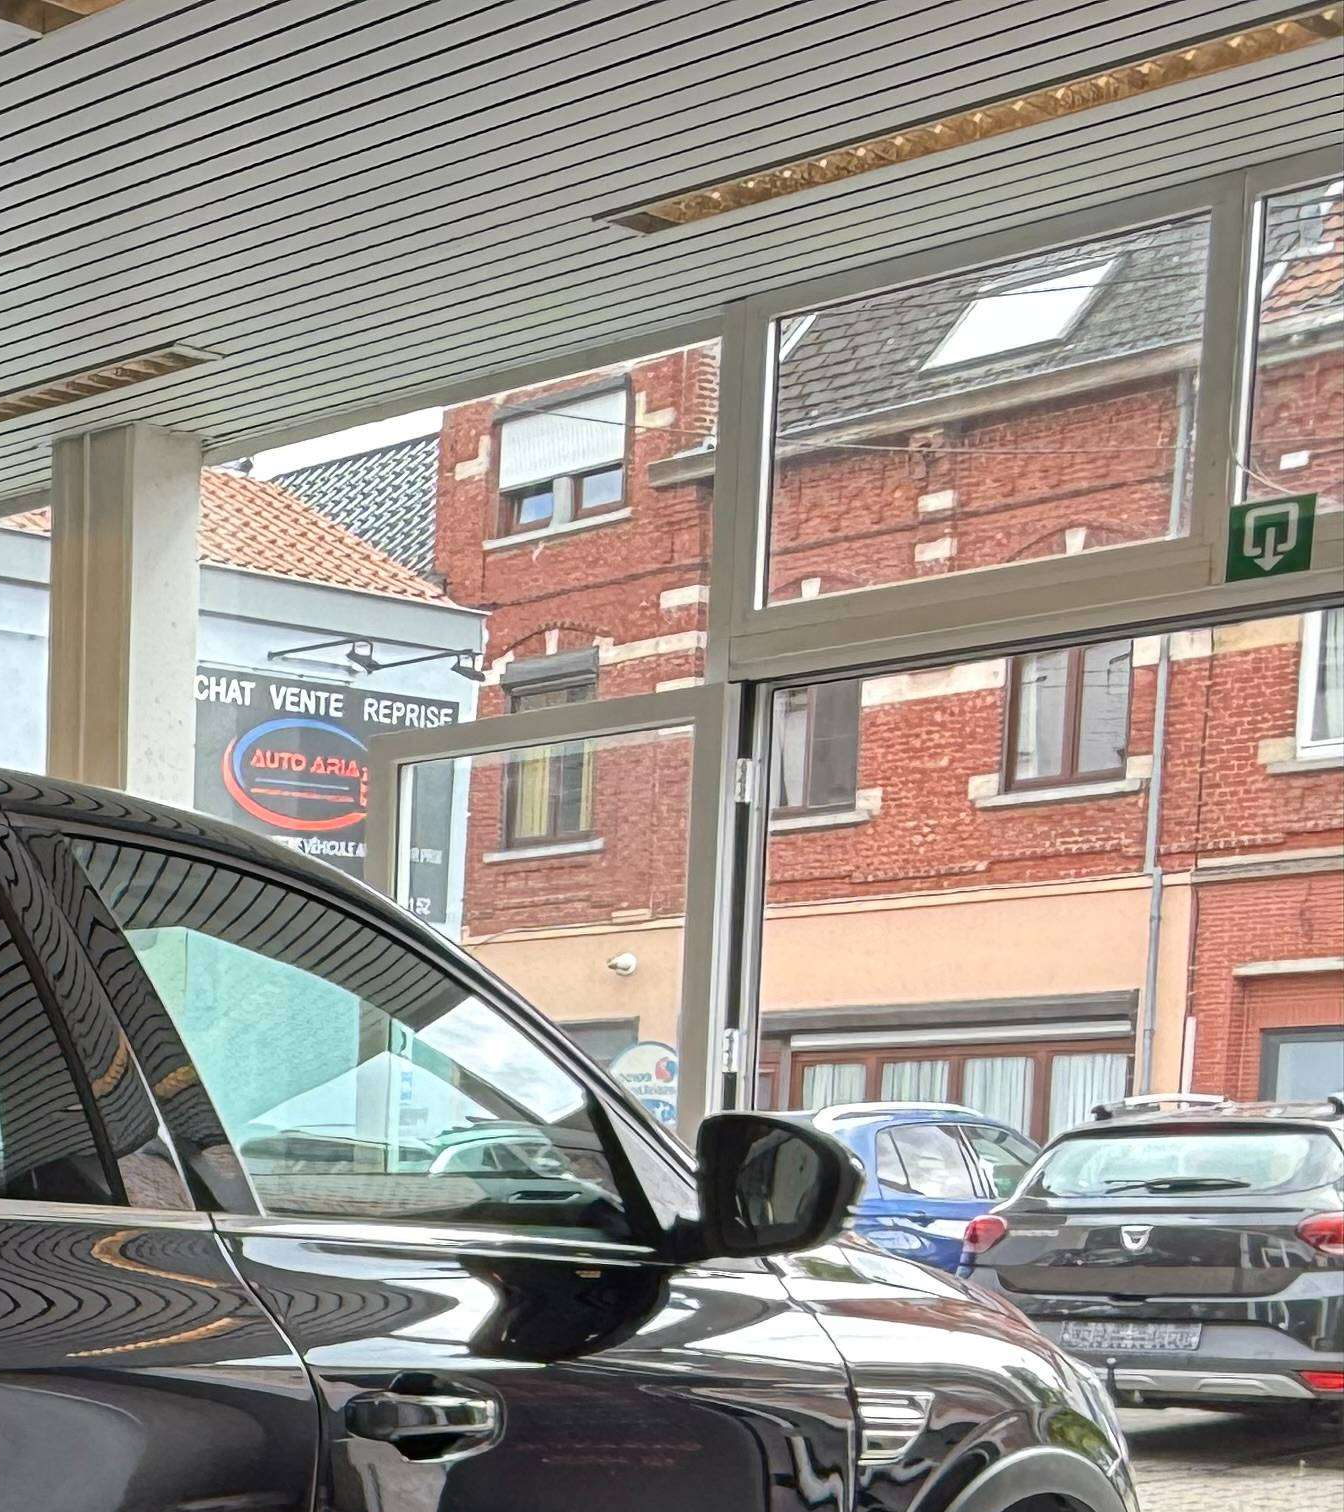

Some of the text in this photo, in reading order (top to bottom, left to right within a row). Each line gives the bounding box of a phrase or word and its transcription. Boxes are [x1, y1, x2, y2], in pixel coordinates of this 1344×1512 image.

[193, 674, 454, 728] CHAT VENTE REPRISE
[250, 748, 360, 777] AUTO ARIA
